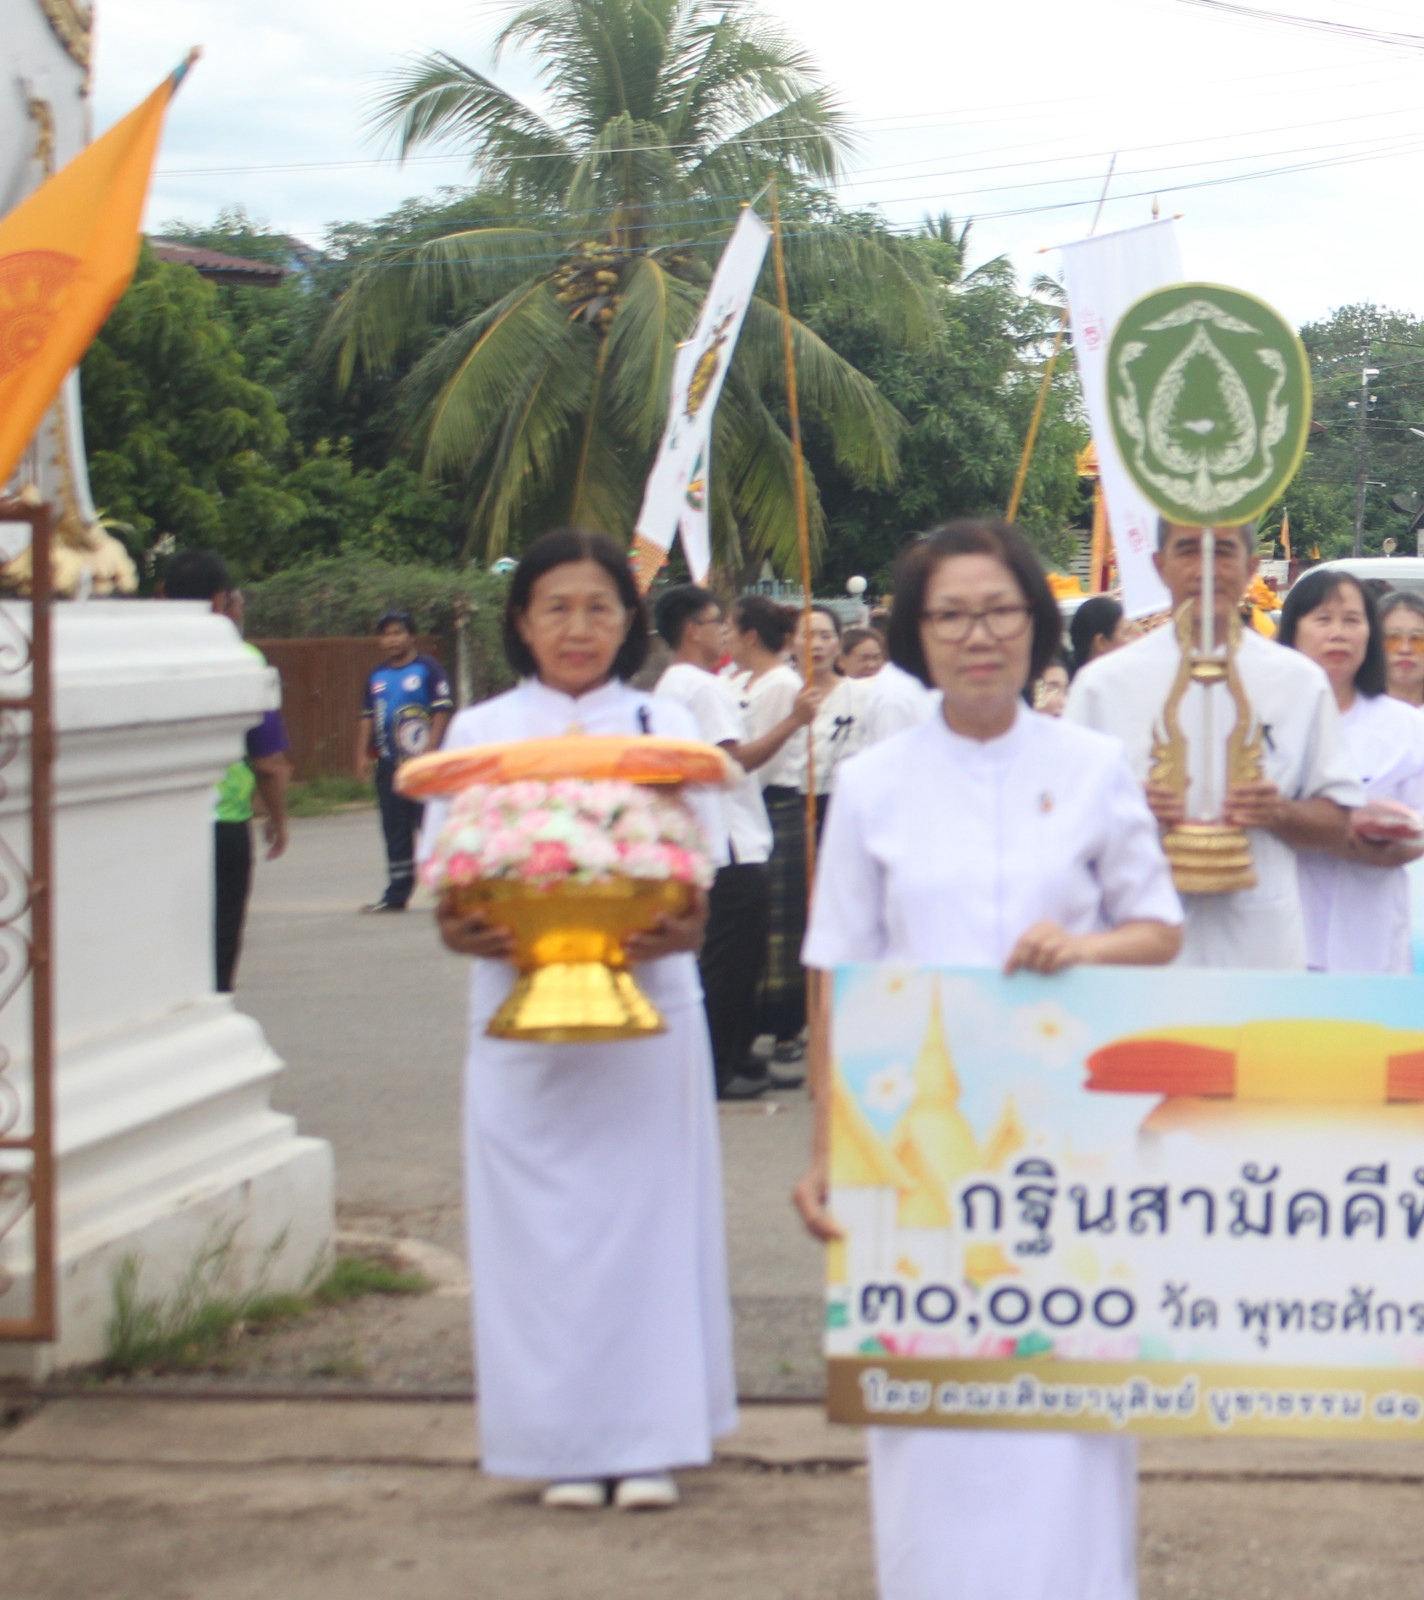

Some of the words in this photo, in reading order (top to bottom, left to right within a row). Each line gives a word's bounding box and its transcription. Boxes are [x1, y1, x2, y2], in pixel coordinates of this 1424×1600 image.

[858, 1283, 1138, 1338] ๓๐,๐๐๐
[1160, 1284, 1219, 1334] วัด
[865, 1374, 928, 1412] โดย
[941, 1377, 1198, 1422] คณะศิษยานุศิษย์
[1212, 1386, 1362, 1425] บูชาธรรม
